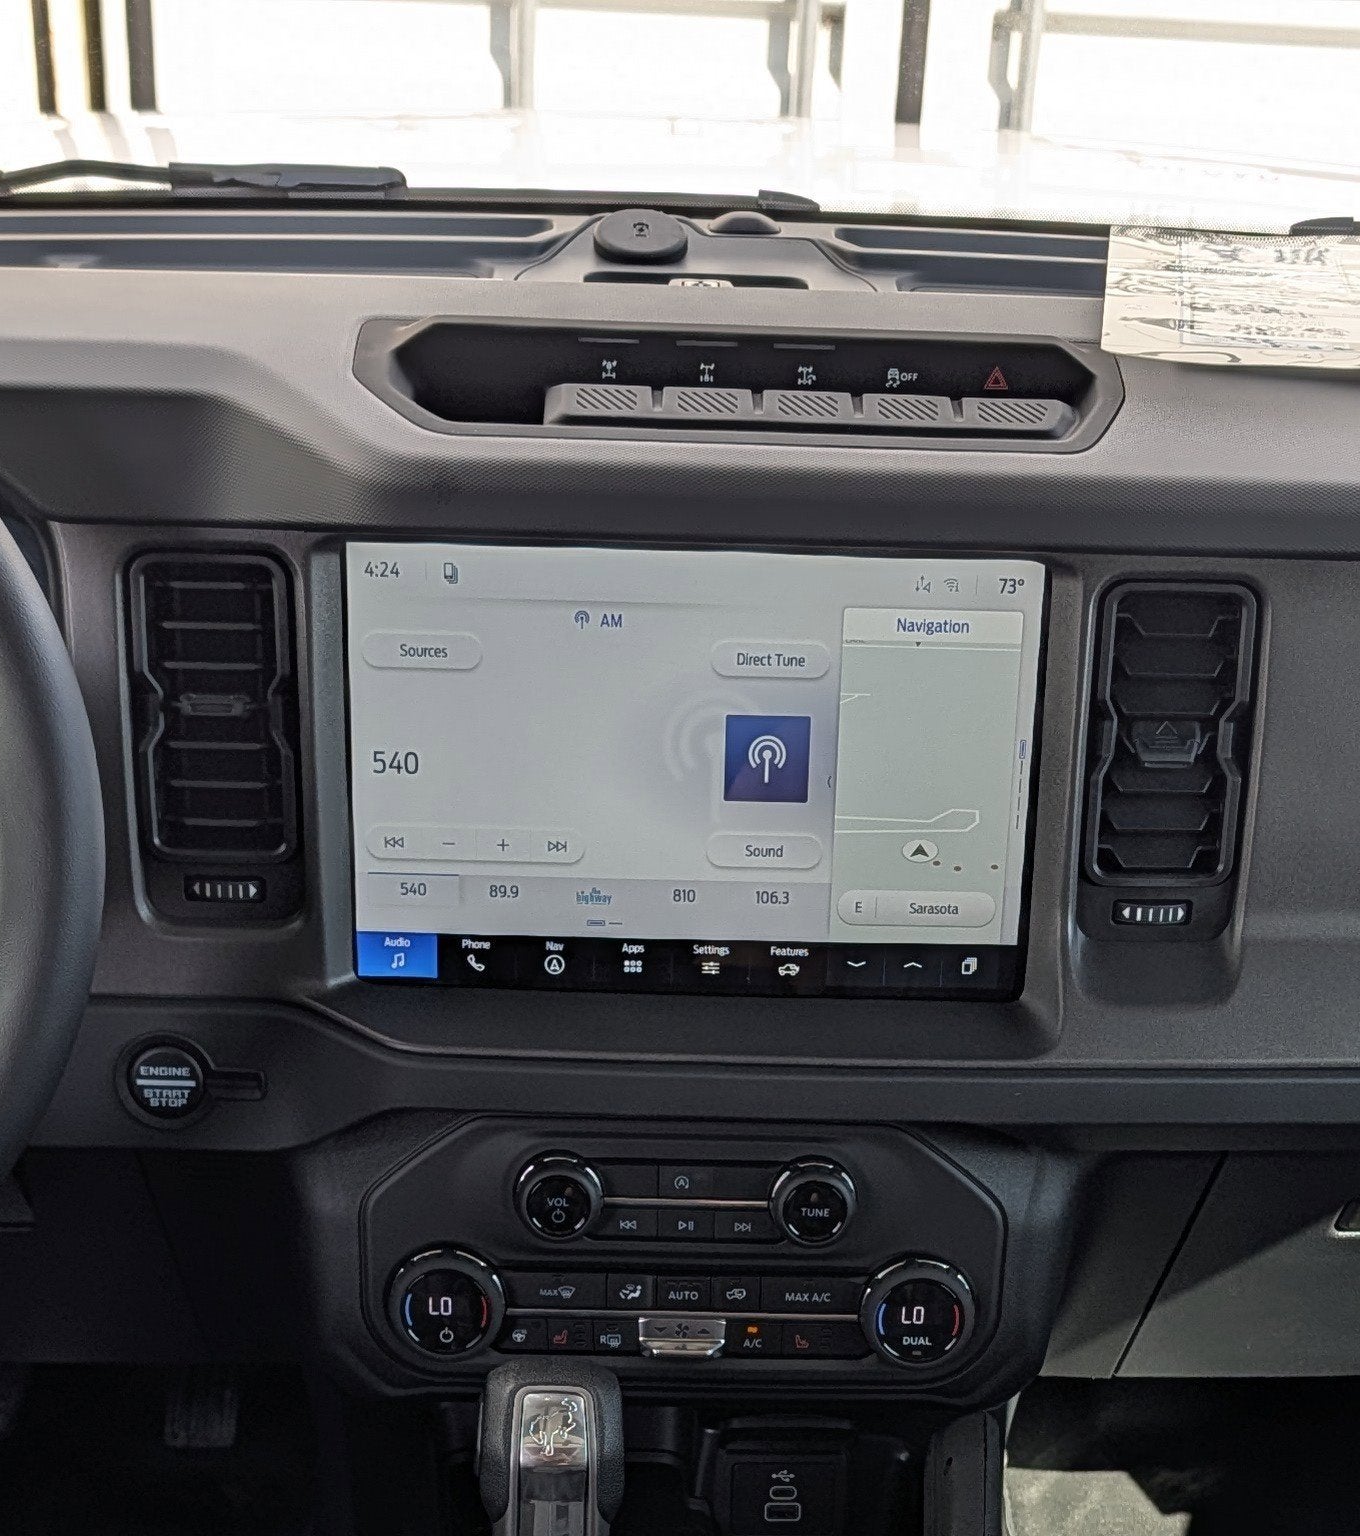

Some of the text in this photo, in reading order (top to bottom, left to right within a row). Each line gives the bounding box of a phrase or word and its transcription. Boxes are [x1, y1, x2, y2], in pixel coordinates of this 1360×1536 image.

[900, 372, 918, 381] OFF
[363, 561, 401, 579] 4:24
[997, 577, 1025, 595] 73°
[599, 613, 624, 629] AM
[896, 617, 970, 636] Navigation
[399, 643, 448, 659] Sources
[736, 652, 805, 668] Direct Tune
[372, 750, 419, 775] 540
[744, 844, 784, 859] Sound
[400, 882, 427, 897] 540
[489, 884, 520, 899] 89.9
[672, 889, 696, 903] 810
[755, 890, 790, 906] 106.3
[854, 901, 863, 913] E
[908, 902, 960, 916] Sarasota
[383, 936, 411, 948] Audio
[461, 938, 491, 950] Phone
[545, 941, 564, 952] Nav
[621, 943, 645, 955] Apps
[692, 944, 730, 957] Settings
[770, 945, 809, 957] Features
[140, 1065, 190, 1077] ENGINE
[143, 1088, 190, 1099] START
[149, 1098, 187, 1107] STOP
[547, 1197, 569, 1207] VOL
[801, 1207, 830, 1218] TUNE
[540, 1288, 558, 1297] MAX
[668, 1290, 699, 1301] AUTO
[785, 1292, 831, 1303] MAX A/C
[428, 1296, 452, 1316] LO
[901, 1306, 925, 1325] LO
[743, 1337, 762, 1349] A/C
[902, 1336, 932, 1346] DUAL
